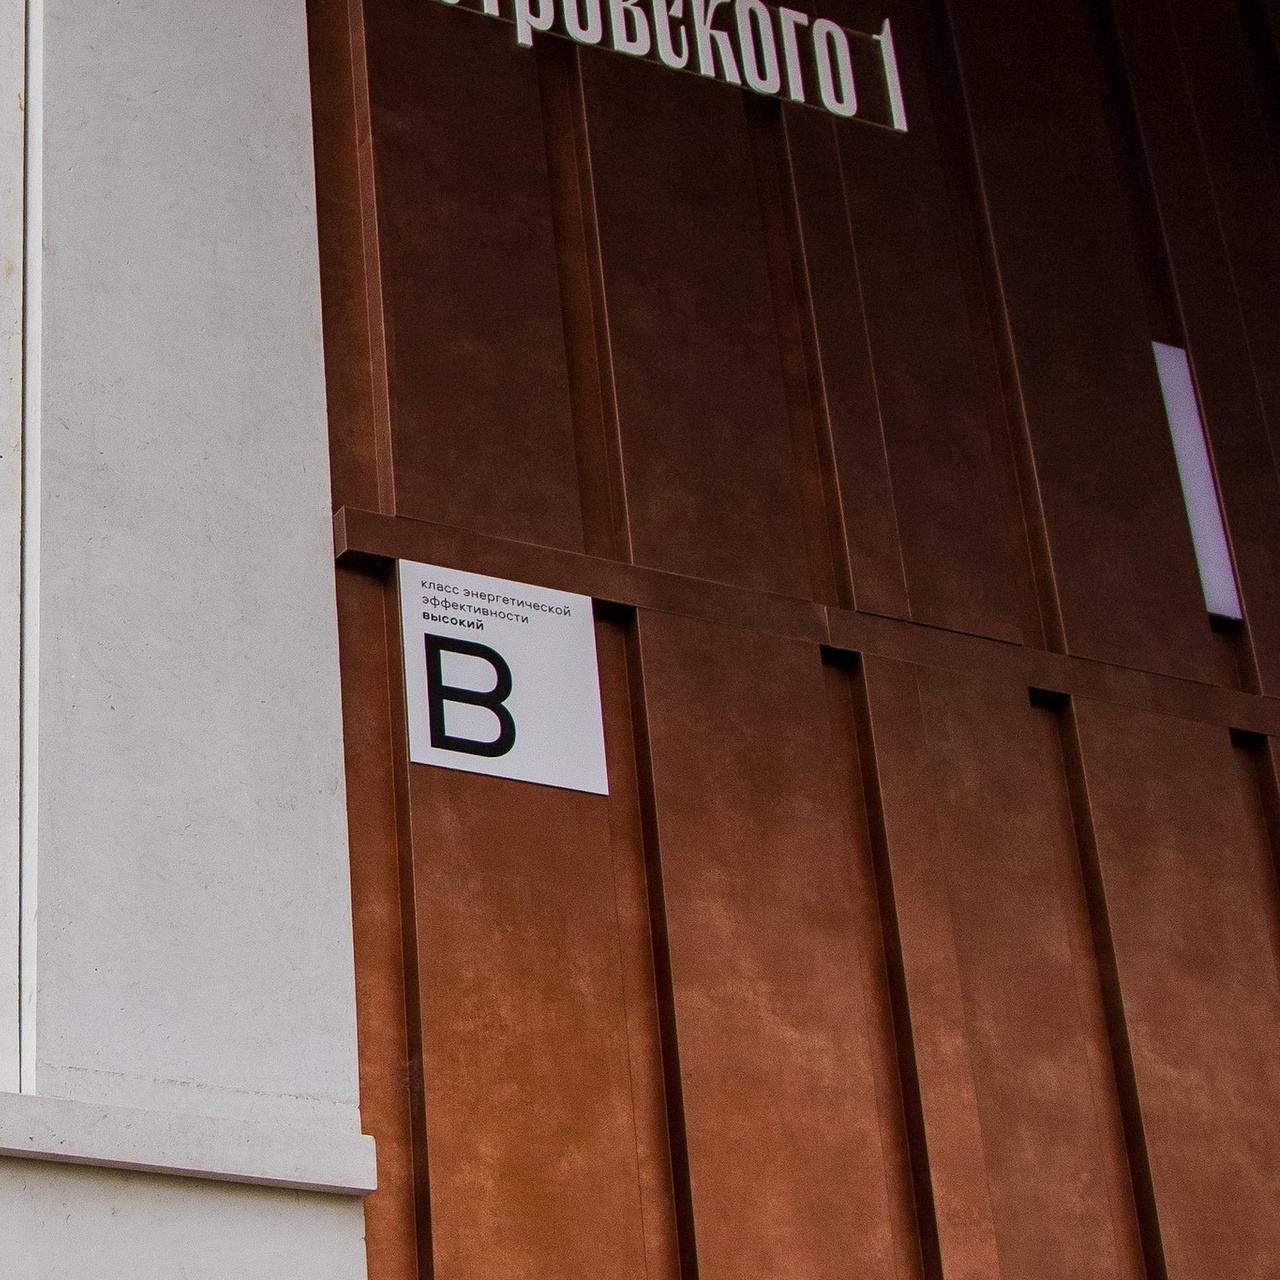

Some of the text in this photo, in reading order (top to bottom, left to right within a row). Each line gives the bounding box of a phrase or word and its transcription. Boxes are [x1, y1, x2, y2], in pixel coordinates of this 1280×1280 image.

[872, 18, 908, 132] 1
[421, 580, 571, 617] класс энергетической
[422, 596, 529, 624] эффективности
[423, 611, 484, 630] высокий
